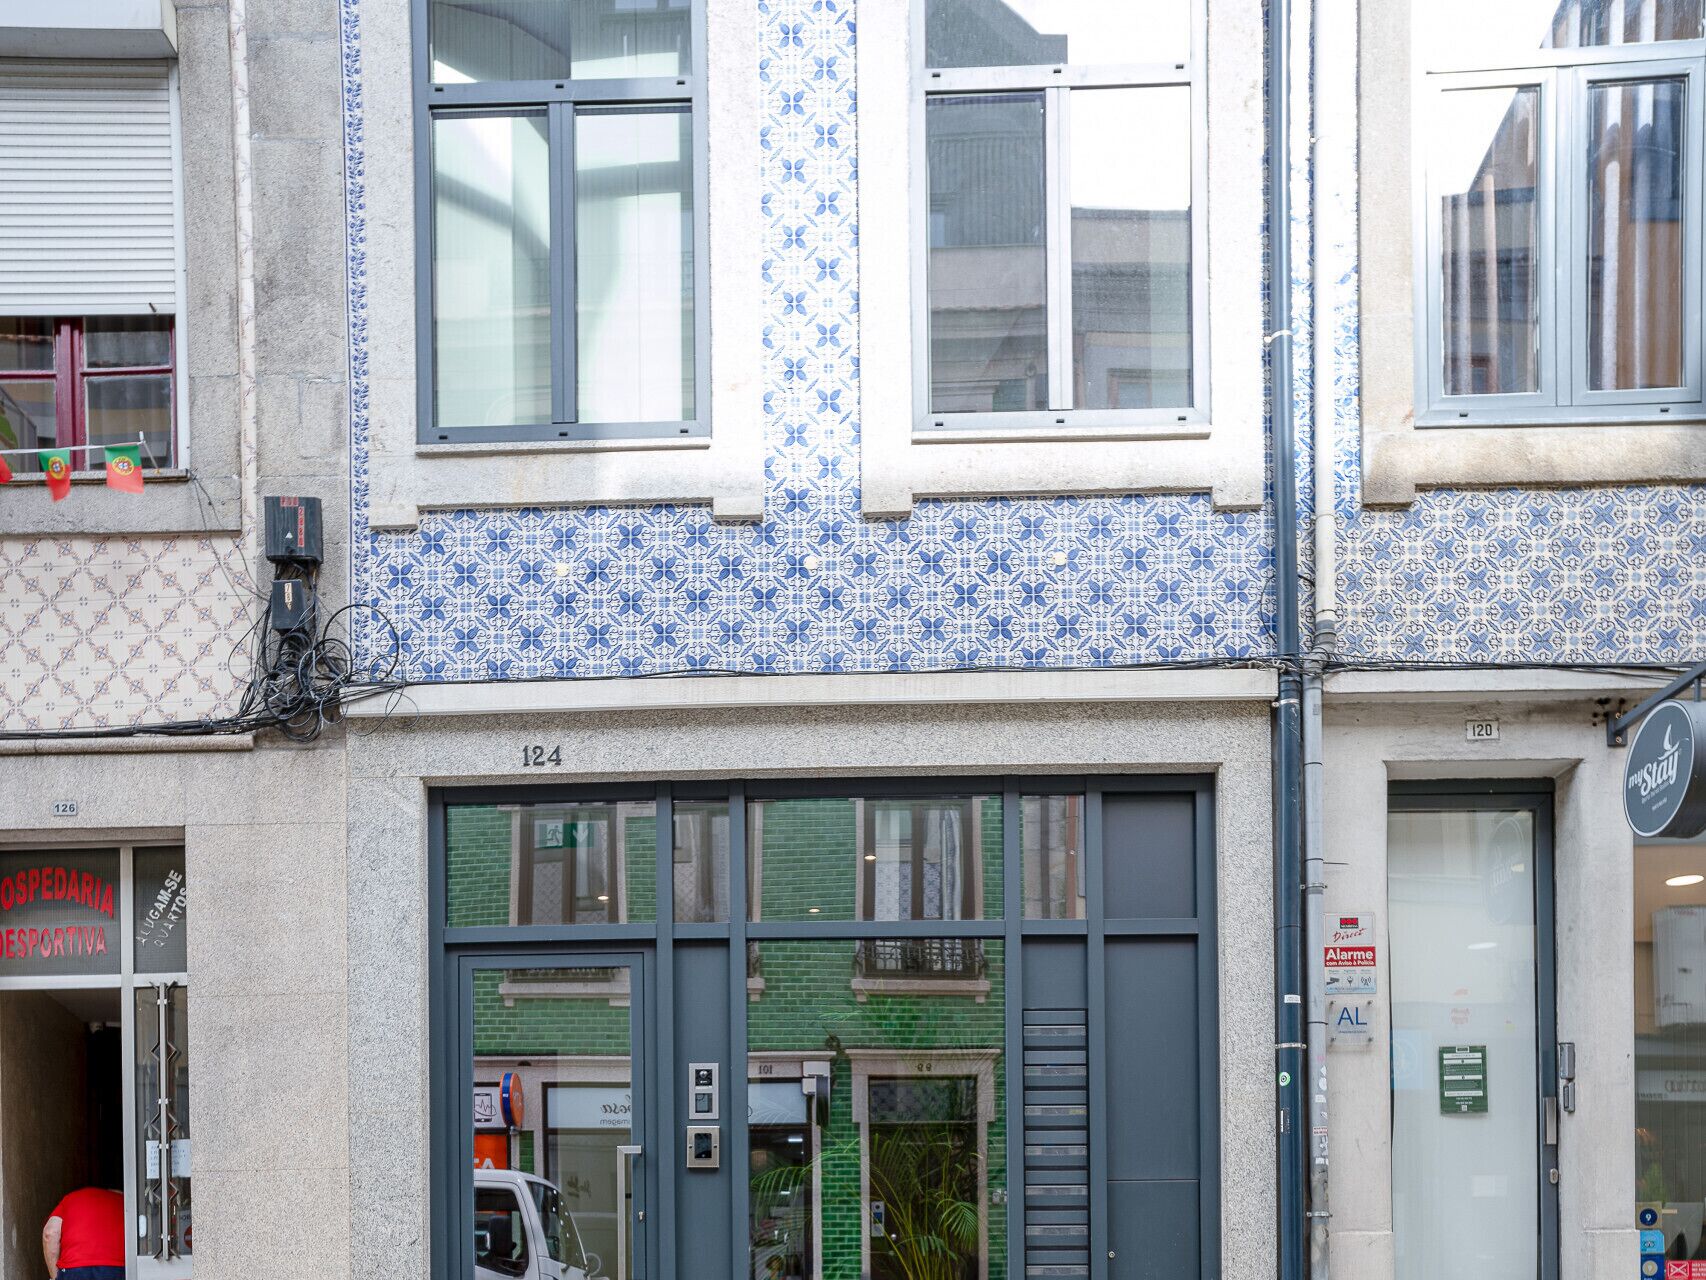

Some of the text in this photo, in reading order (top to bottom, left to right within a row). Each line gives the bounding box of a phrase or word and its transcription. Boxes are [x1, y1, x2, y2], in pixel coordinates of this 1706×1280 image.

[1472, 723, 1493, 738] 120
[522, 745, 562, 767] 124
[54, 803, 76, 814] 126
[135, 869, 183, 947] ALUGAM-SE
[1326, 947, 1374, 960] Alarme
[1337, 1007, 1368, 1026] AL
